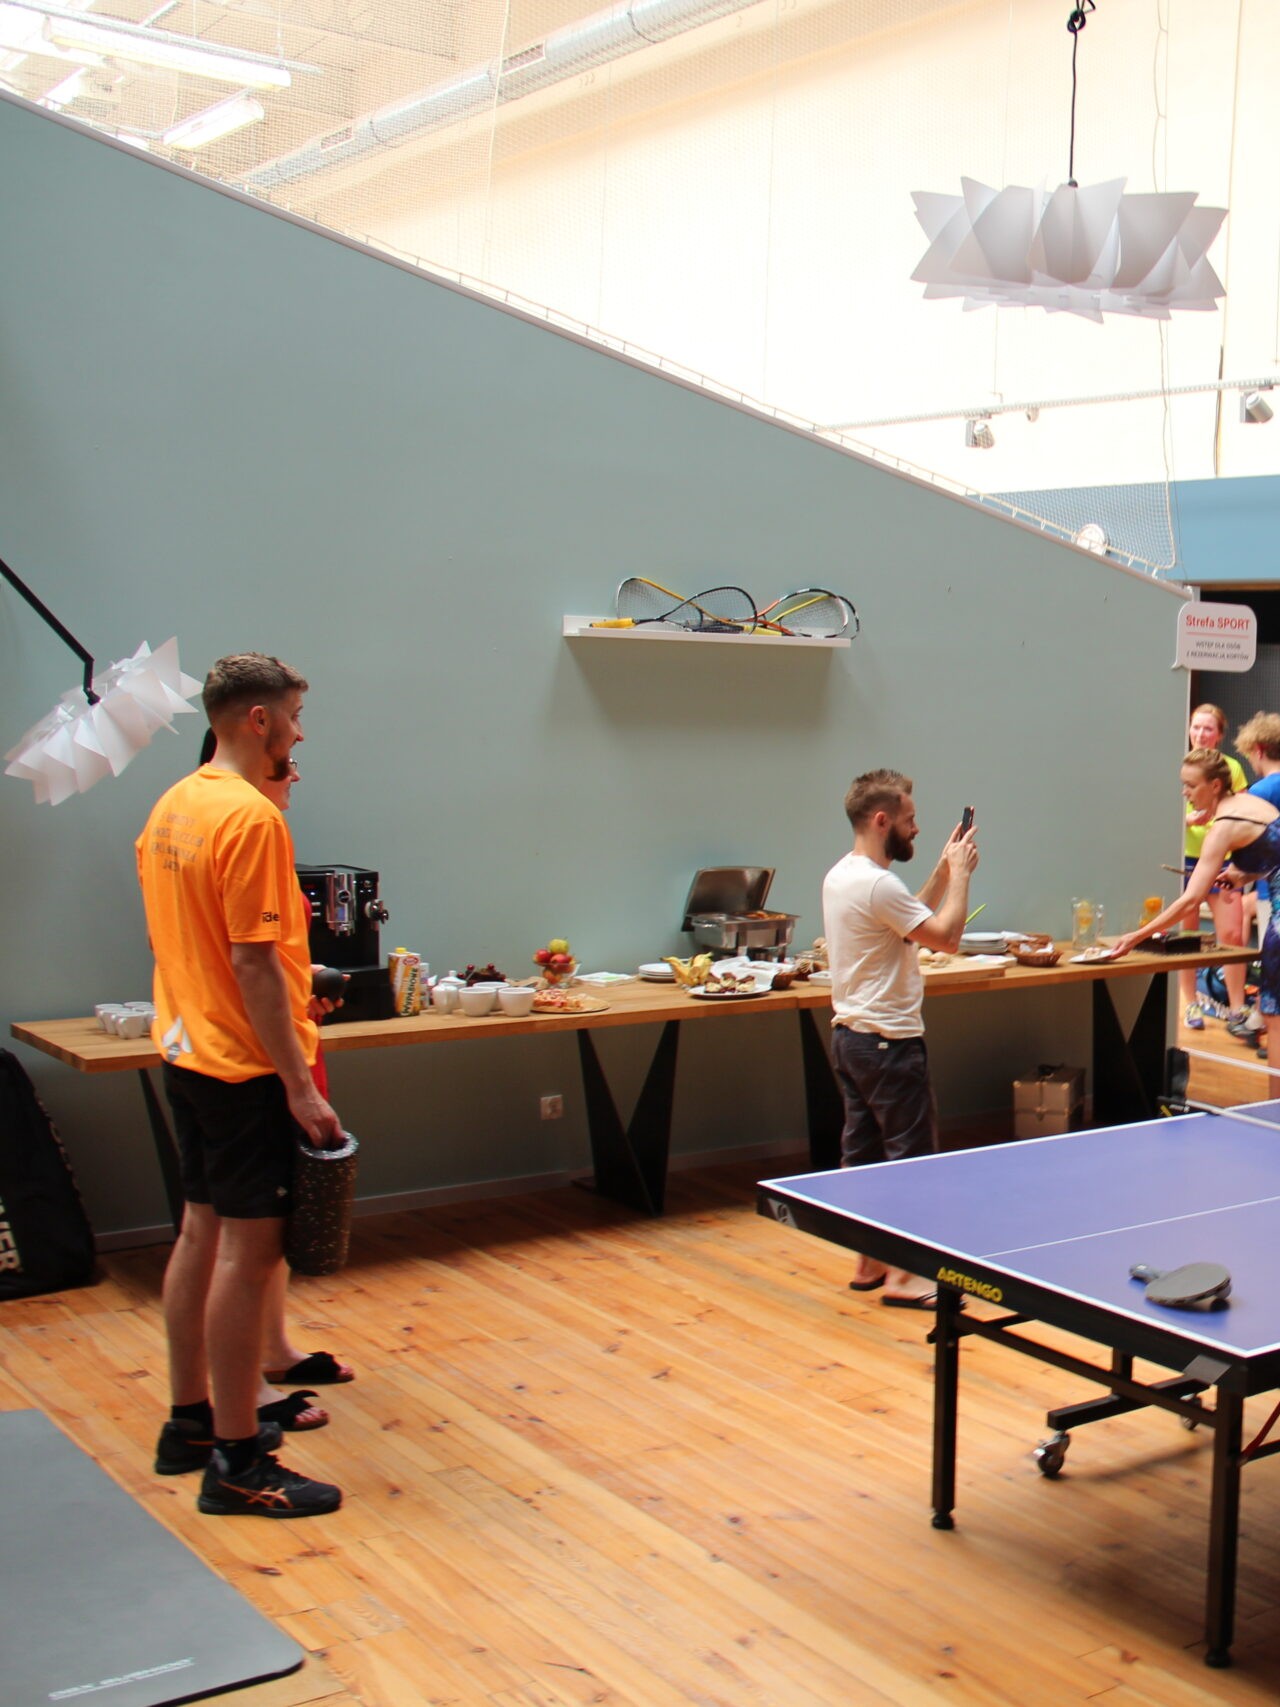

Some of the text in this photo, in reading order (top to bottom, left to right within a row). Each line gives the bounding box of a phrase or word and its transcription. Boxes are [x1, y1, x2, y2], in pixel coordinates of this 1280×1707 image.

[1186, 615, 1250, 631] Strefa SPORT
[937, 1266, 1003, 1303] ARTENGO
